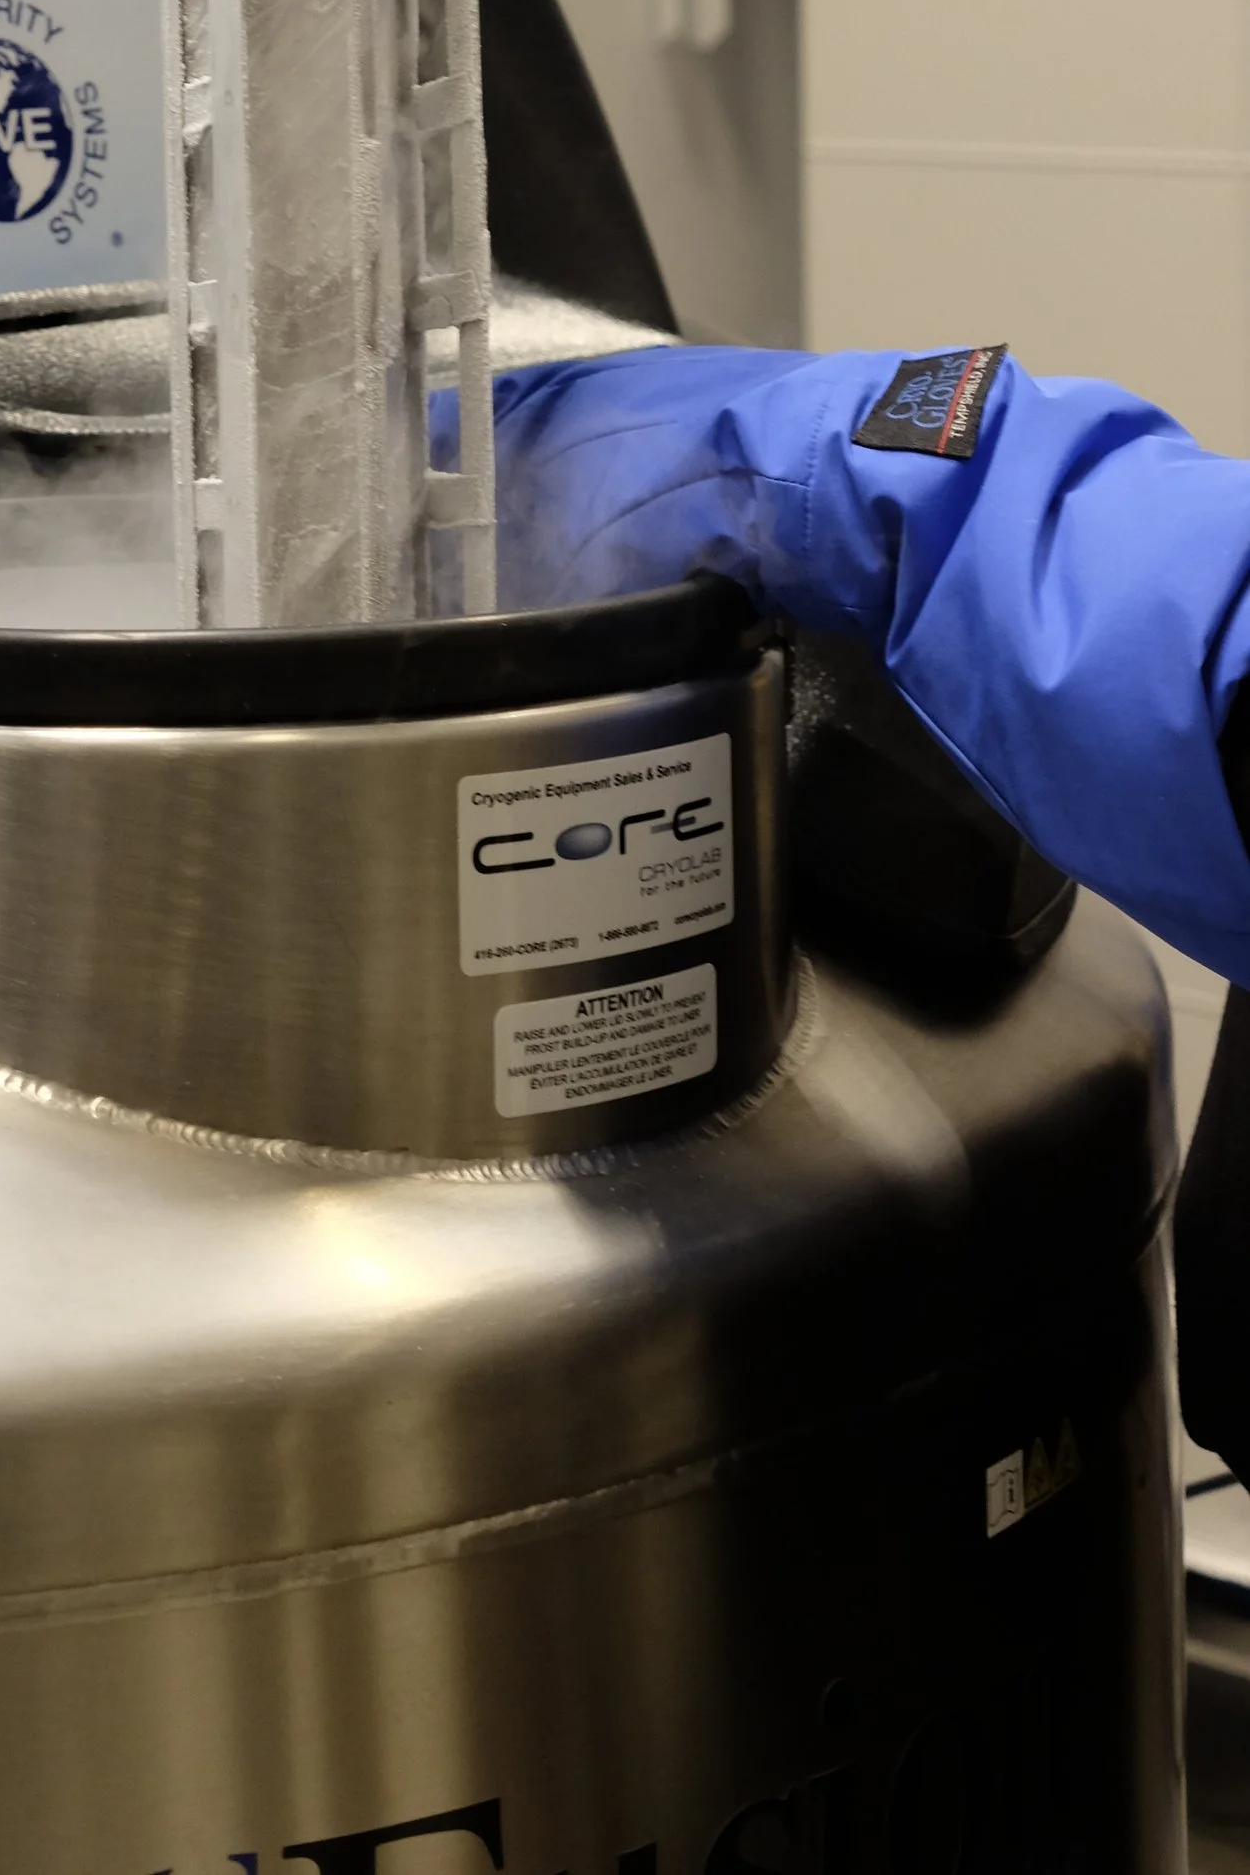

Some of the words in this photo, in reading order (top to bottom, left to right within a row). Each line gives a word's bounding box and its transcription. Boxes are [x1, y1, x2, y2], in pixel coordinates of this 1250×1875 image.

[49, 81, 110, 246] SYSTEMS
[470, 784, 542, 808] Cryogenic
[545, 775, 612, 799] Equipment
[612, 770, 644, 788] Sales
[646, 768, 655, 781] &
[656, 760, 692, 780] Service
[638, 848, 722, 883] CRYOLAB
[639, 884, 660, 898] for
[664, 879, 686, 892] the
[688, 867, 722, 887] future
[575, 982, 665, 1018] ATTENTION
[514, 1027, 546, 1043] RAISE
[548, 1023, 570, 1038] AND
[572, 1017, 607, 1034] LOWER
[524, 1039, 560, 1055] FROST
[507, 1059, 570, 1077] MANIPULER
